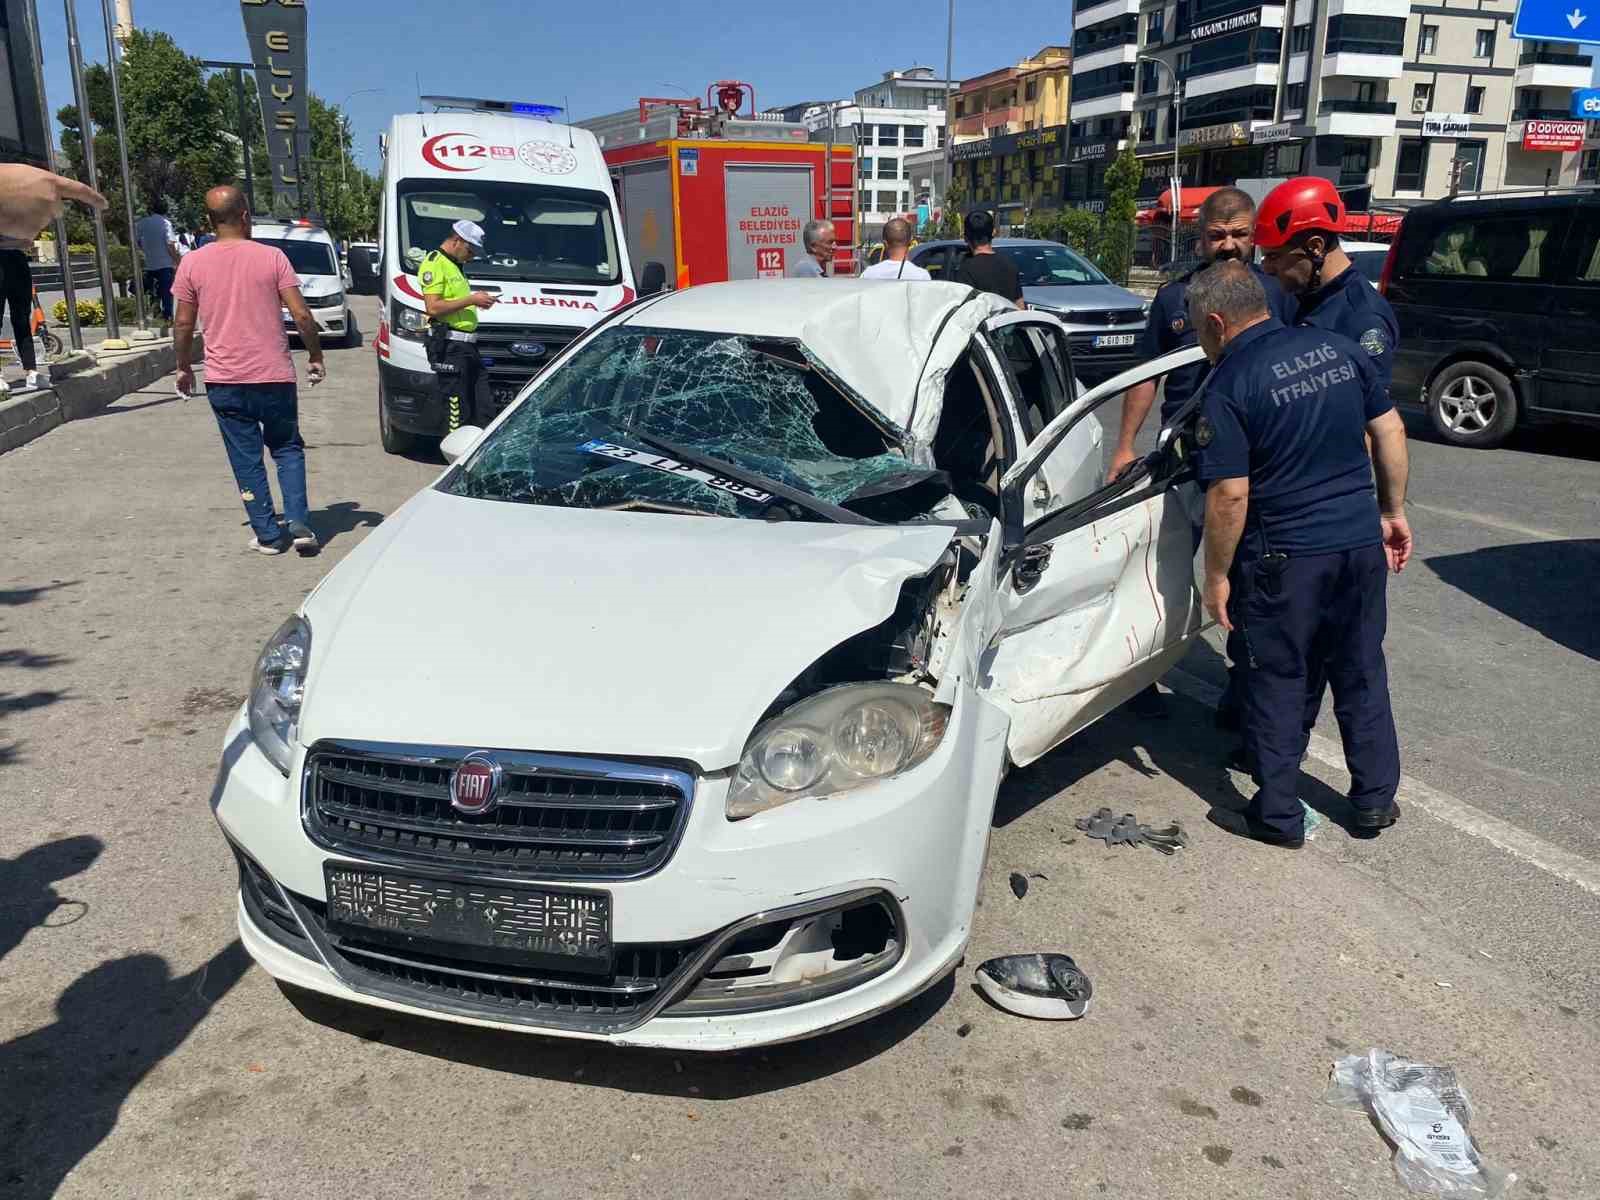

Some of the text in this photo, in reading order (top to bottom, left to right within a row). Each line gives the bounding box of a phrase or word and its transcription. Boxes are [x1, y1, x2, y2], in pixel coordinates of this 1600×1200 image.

[434, 145, 488, 158] 112
[760, 251, 781, 268] 112
[1271, 342, 1337, 380] ELAZIĞ
[1270, 360, 1357, 407] İTFAİYESİ
[592, 444, 638, 459] 23
[650, 458, 695, 473] LP
[460, 774, 488, 799] FIAT
